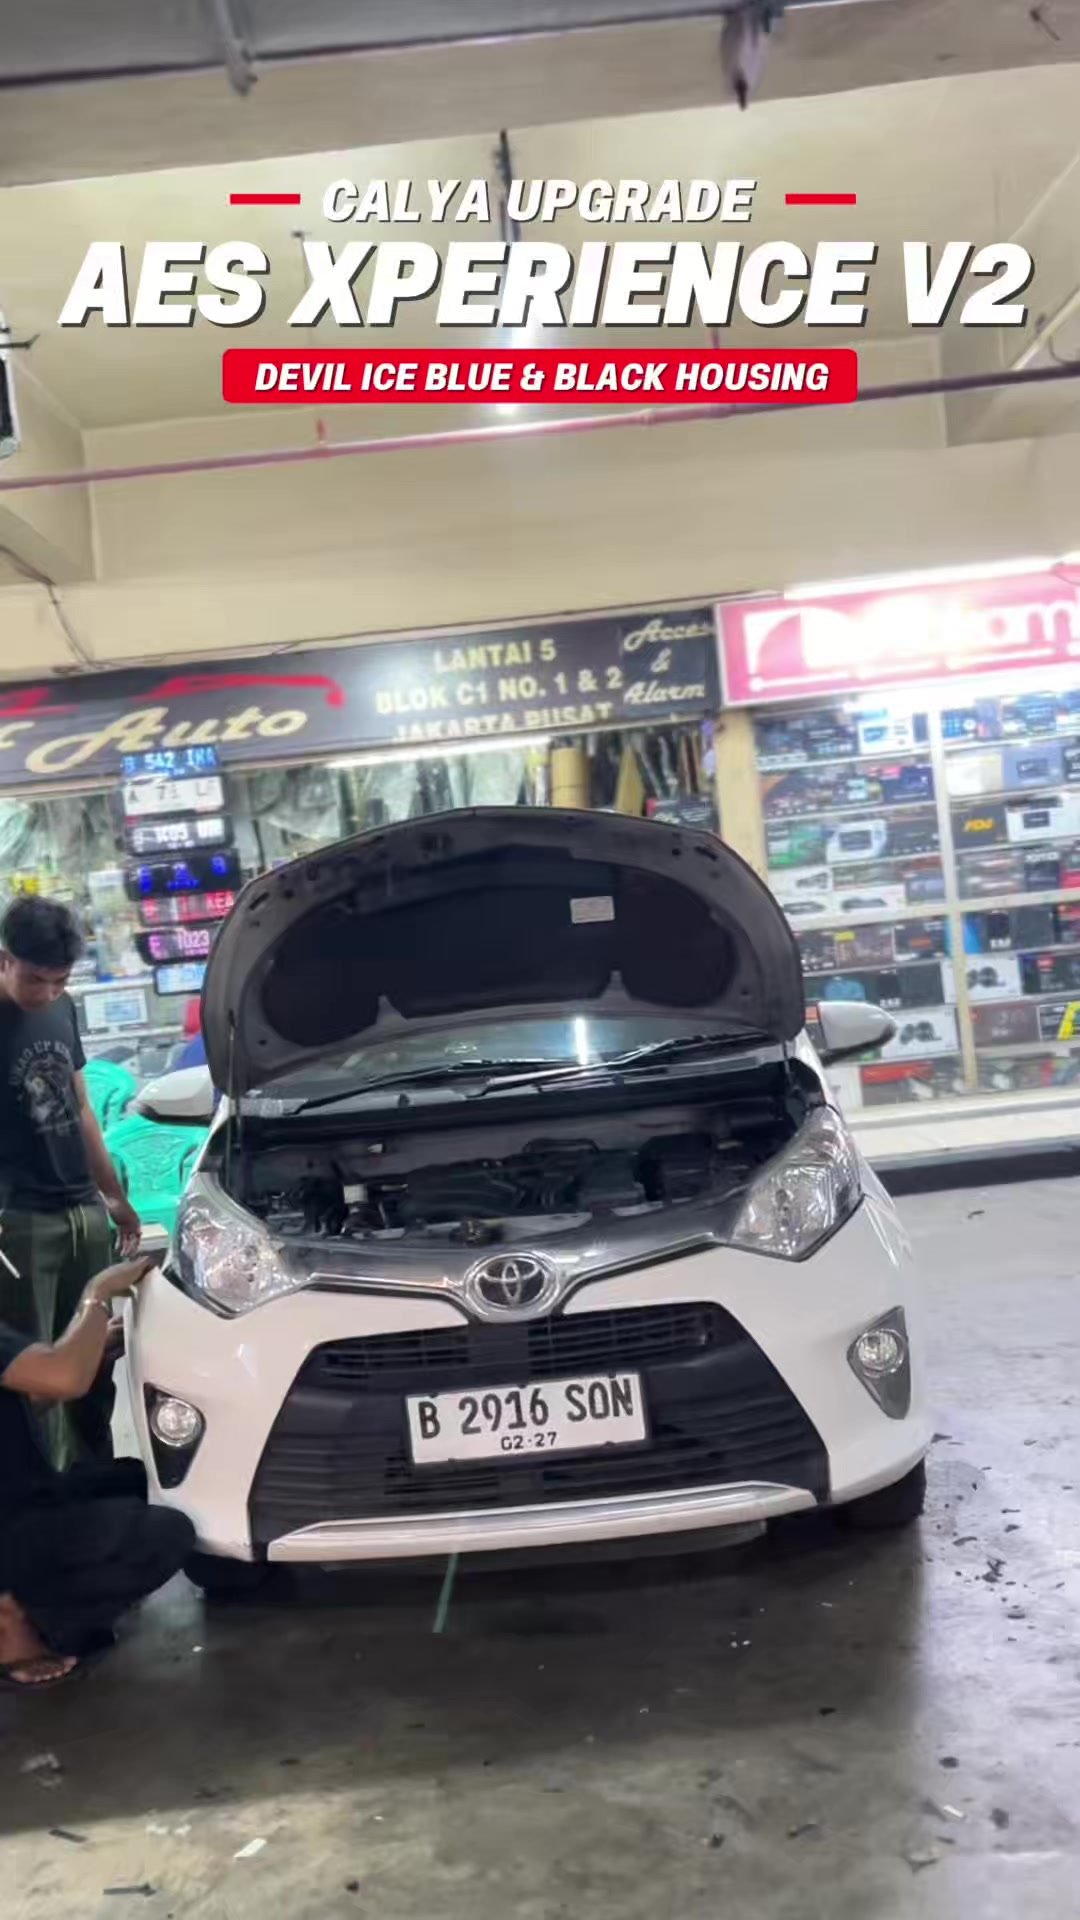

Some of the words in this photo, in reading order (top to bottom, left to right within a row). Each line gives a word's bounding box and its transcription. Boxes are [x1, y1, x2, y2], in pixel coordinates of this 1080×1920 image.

[433, 640, 532, 674] LANTAI
[540, 638, 557, 662] 5
[375, 683, 449, 716] BLOK
[457, 680, 487, 707] C1
[498, 675, 547, 701] NO.
[554, 672, 568, 695] 1
[577, 668, 597, 693] &
[606, 665, 622, 690] 2
[623, 680, 705, 705] Alarm
[25, 706, 308, 774] Auto
[391, 713, 516, 744] JAKARTA
[418, 1401, 441, 1440] B
[457, 1388, 549, 1436] 2916
[565, 1377, 634, 1422] SON
